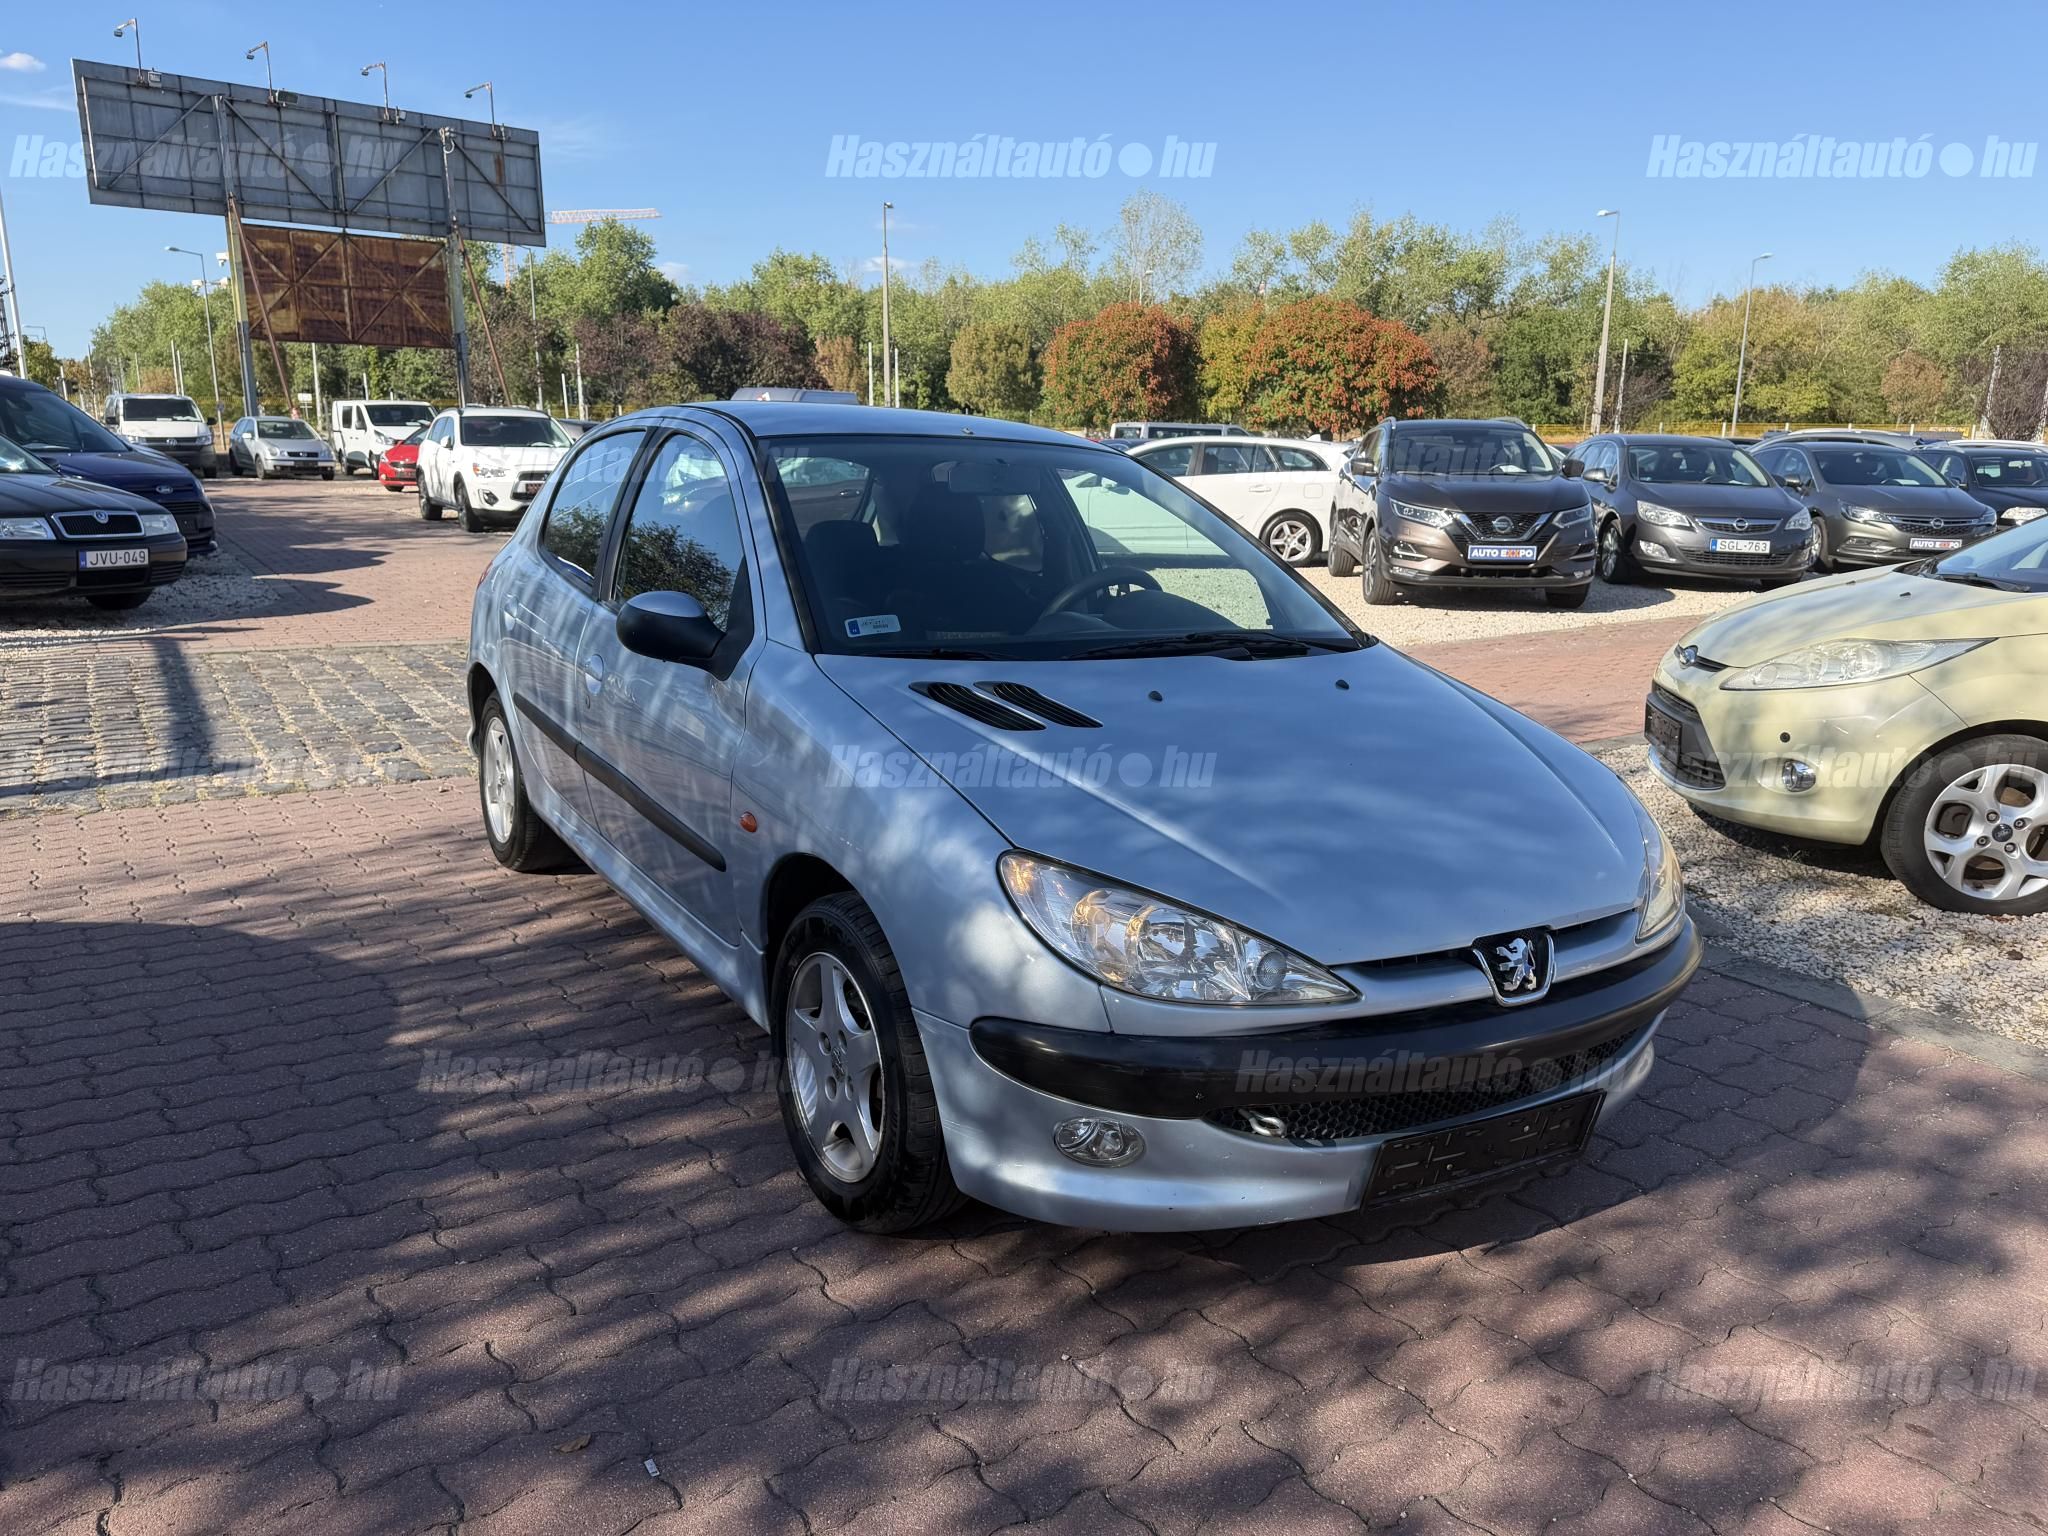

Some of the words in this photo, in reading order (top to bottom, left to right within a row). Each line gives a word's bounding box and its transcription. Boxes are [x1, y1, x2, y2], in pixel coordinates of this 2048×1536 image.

[1719, 540, 1768, 552] SGL-763
[89, 550, 146, 566] JVU-049
[1471, 548, 1499, 557] AUTO
